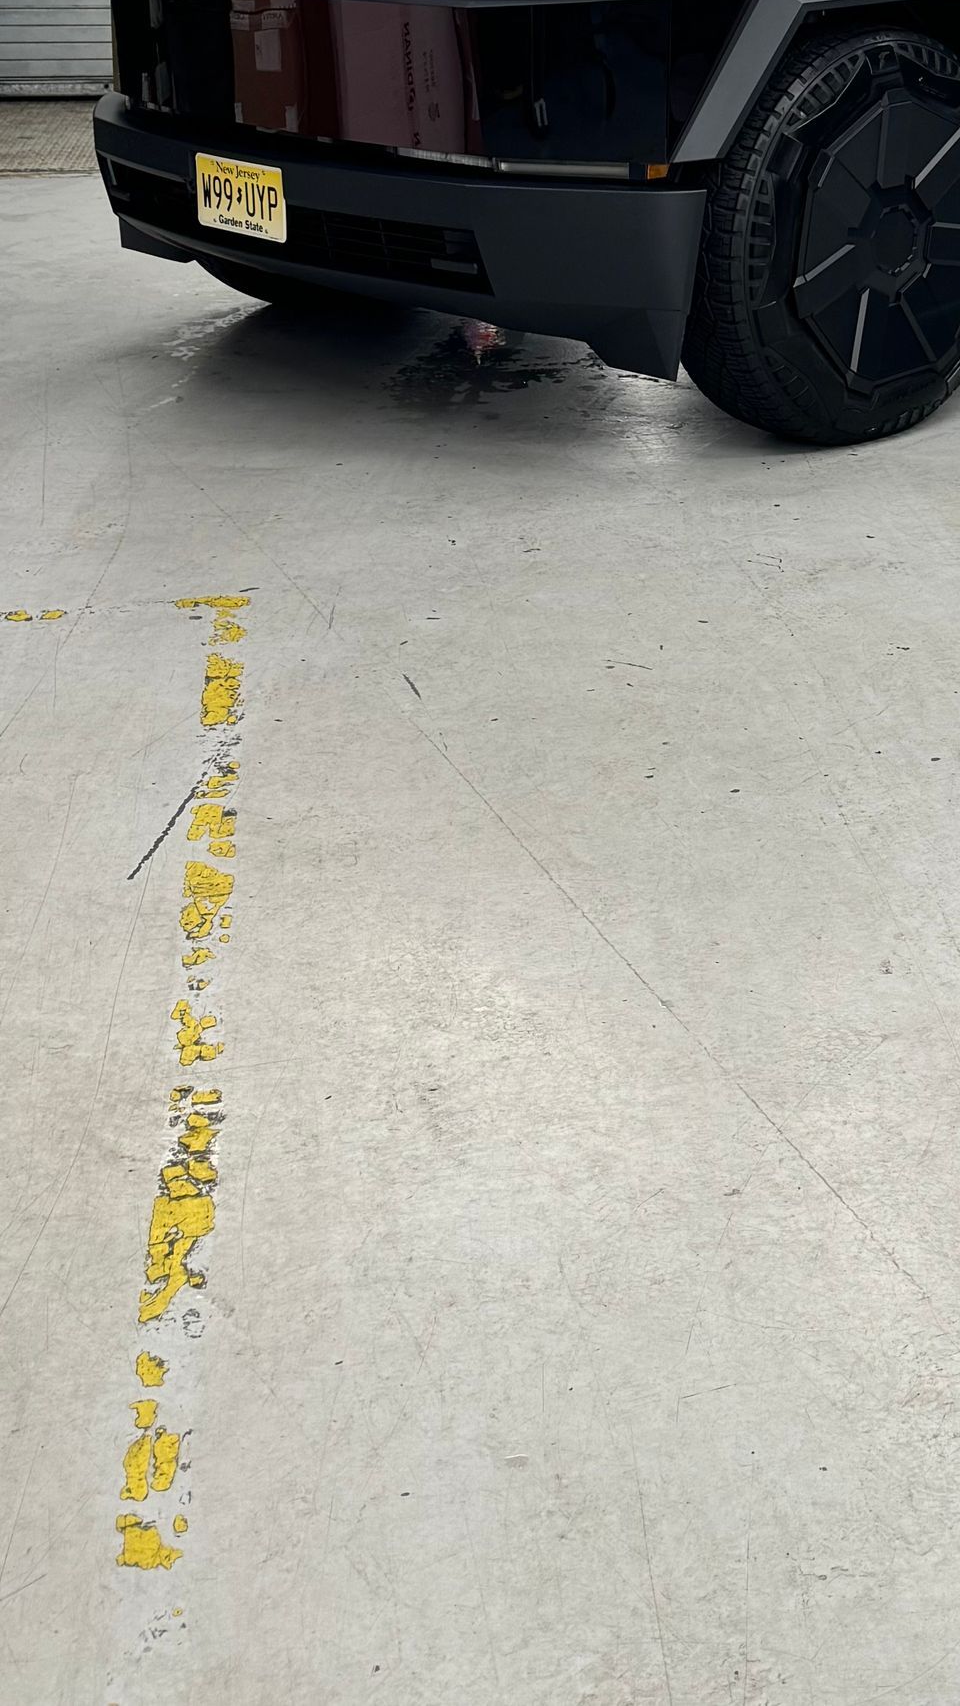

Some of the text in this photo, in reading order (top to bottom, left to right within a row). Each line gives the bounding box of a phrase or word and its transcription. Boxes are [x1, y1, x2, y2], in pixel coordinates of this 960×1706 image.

[215, 161, 260, 182] New Jersey
[219, 215, 263, 233] Garden State
